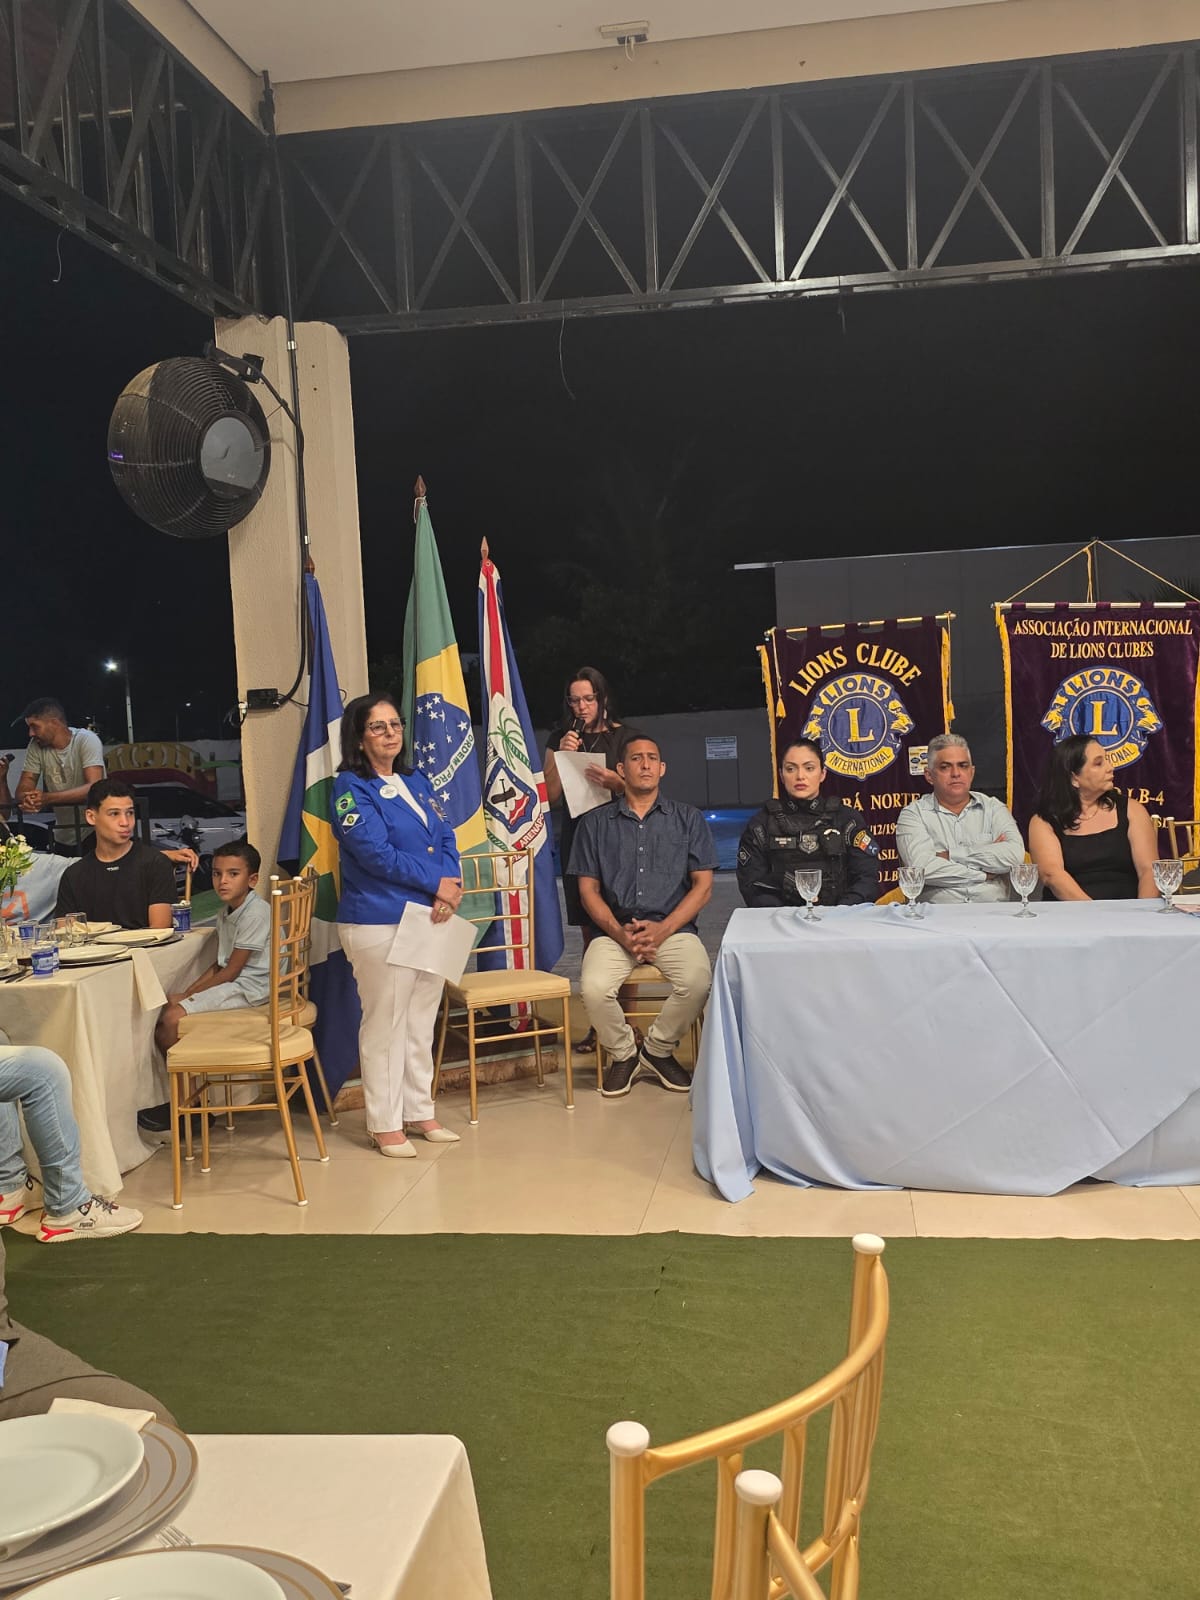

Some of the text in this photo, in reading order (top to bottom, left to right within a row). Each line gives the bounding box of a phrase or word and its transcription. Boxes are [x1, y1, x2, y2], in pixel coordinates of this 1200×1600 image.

[1014, 618, 1193, 640] ASSOCIAÇÃO INTERNACIONAL
[1050, 641, 1154, 659] DE LIONS CLUBES
[788, 642, 922, 696] LIONS CLUBE
[1067, 670, 1137, 694] LIONS
[822, 676, 888, 702] LIONS
[845, 707, 875, 743] L
[1090, 700, 1118, 735] L
[452, 734, 474, 766] ORDEM
[829, 751, 891, 772] INTERNATIONAL
